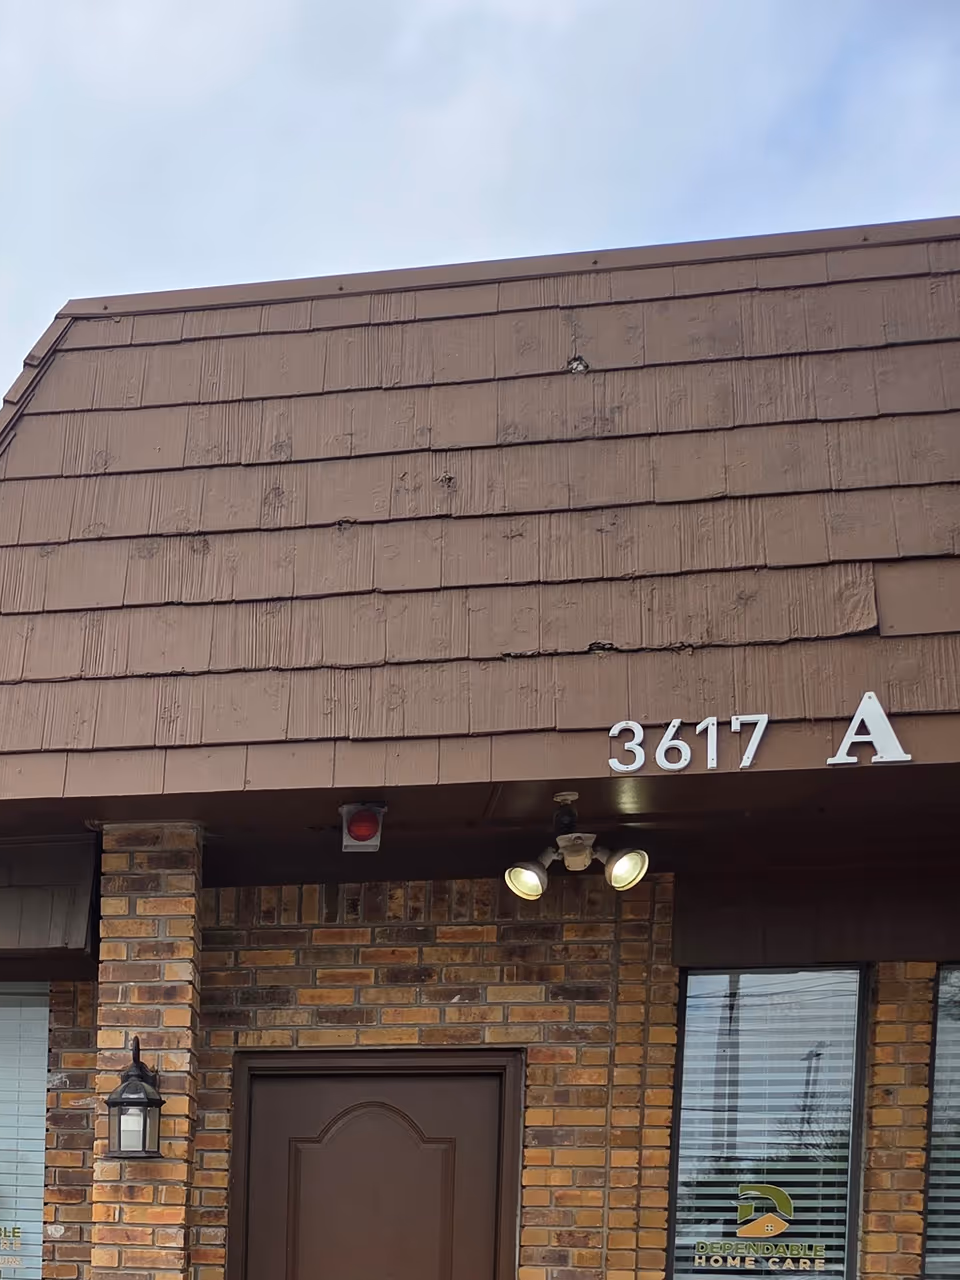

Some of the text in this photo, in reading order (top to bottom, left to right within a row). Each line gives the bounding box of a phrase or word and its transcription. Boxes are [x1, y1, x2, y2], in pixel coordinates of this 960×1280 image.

[607, 691, 912, 773] 3617 A
[696, 1241, 826, 1257] DEPENDABLE
[694, 1256, 826, 1270] HOME CARE
